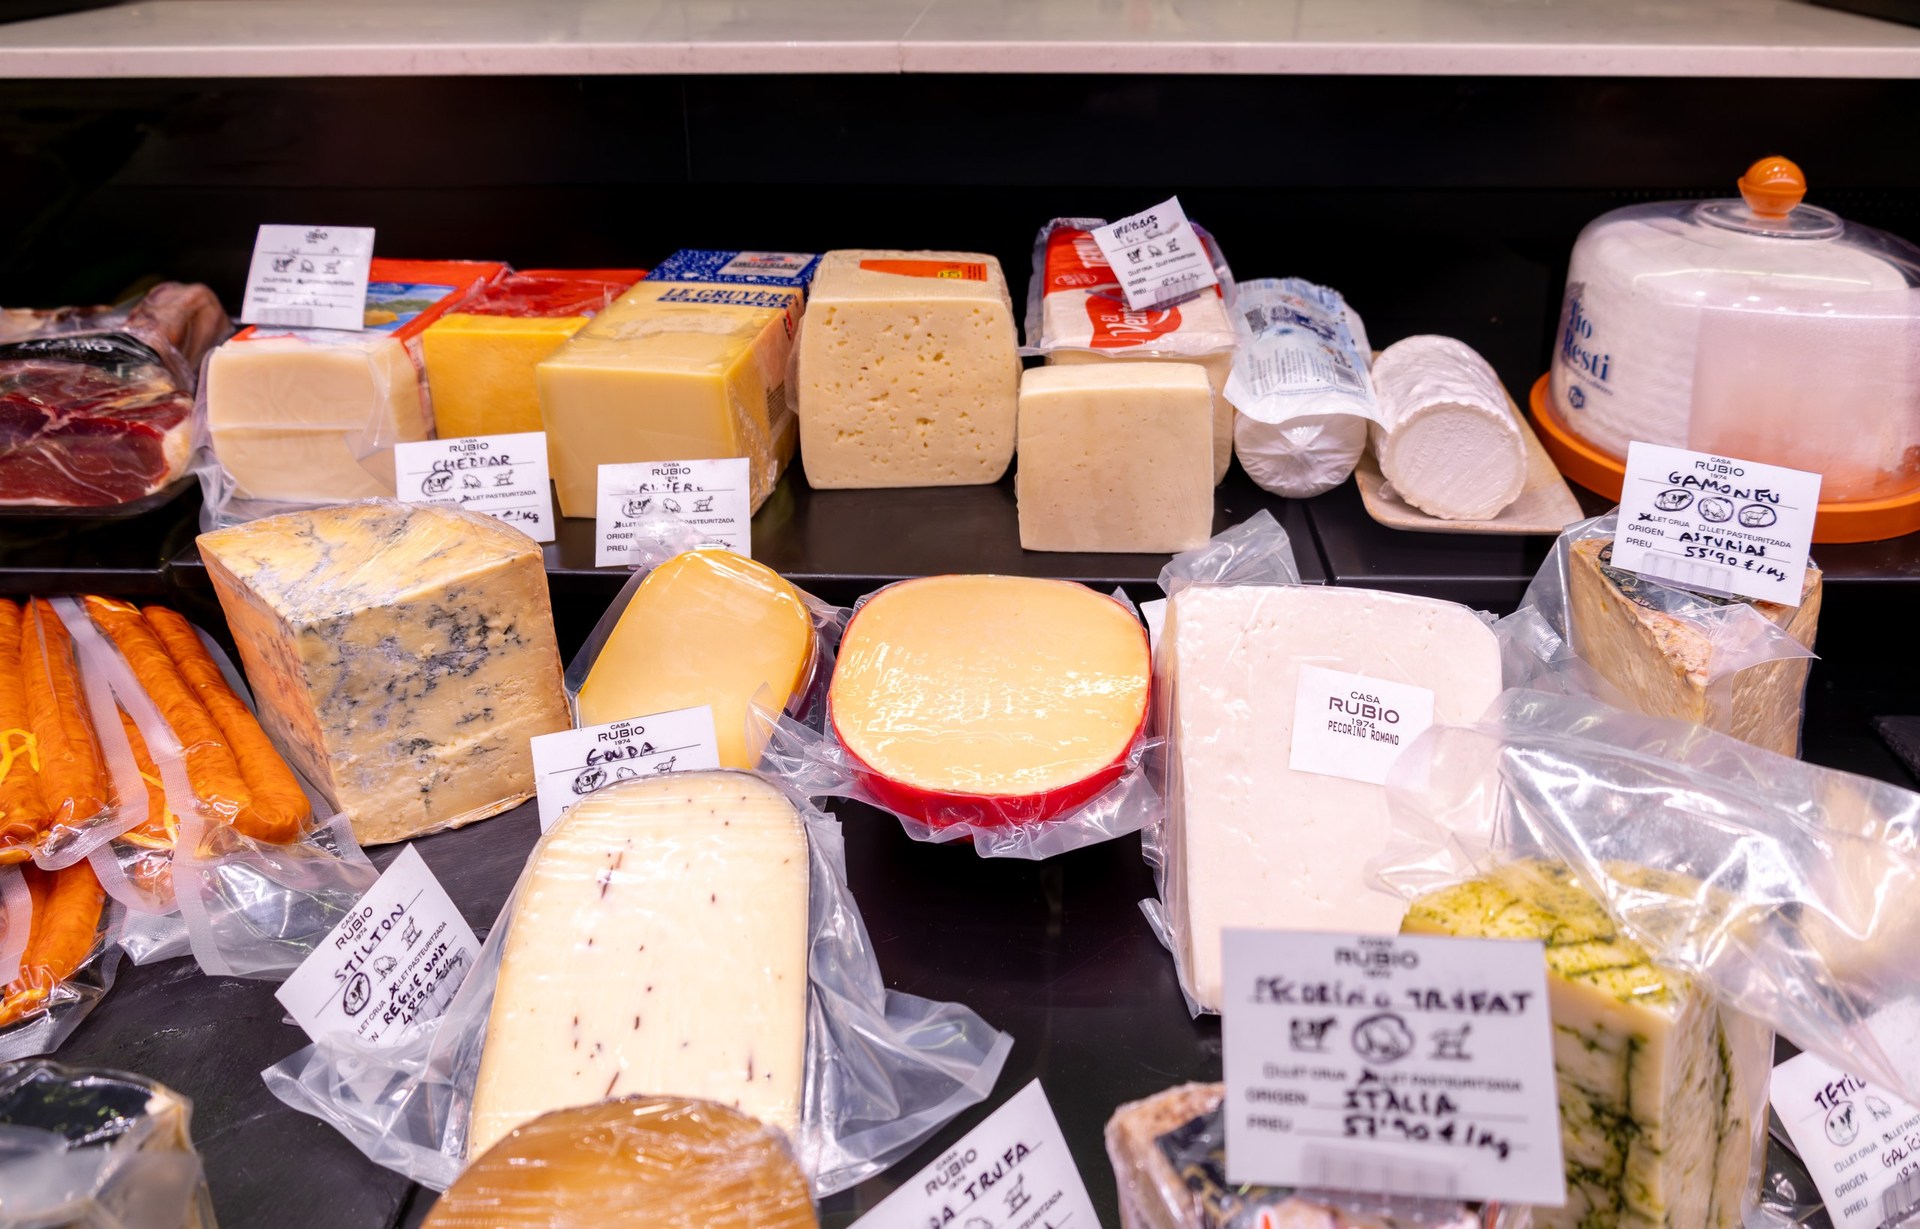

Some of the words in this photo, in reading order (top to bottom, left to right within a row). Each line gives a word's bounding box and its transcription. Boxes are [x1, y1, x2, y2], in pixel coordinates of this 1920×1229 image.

[666, 288, 694, 297] LE
[449, 442, 489, 453] RUBIO
[432, 455, 512, 473] CHEDDAR
[1695, 461, 1744, 477] RUBIO
[1710, 457, 1731, 465] CASA
[652, 468, 691, 476] RUBIO
[485, 490, 537, 500] PASTEURITZADA
[1628, 523, 1664, 537] ORIGEN
[1679, 532, 1766, 557] ASTURIAS
[1668, 518, 1690, 527] CRUA
[1706, 527, 1725, 536] LLET
[1727, 530, 1792, 548] PASTEURITZADA
[1626, 537, 1652, 549] PREU
[1684, 546, 1737, 566] 55'90
[1350, 691, 1380, 704] CASA
[1329, 696, 1400, 724] RUBIO
[610, 722, 631, 730] CASA
[1328, 720, 1367, 738] PECORINO
[1371, 729, 1400, 746] ROMANO
[1351, 718, 1375, 729] 1974
[597, 725, 645, 743] RUBIO
[614, 738, 631, 746] 1974
[586, 742, 656, 766] GOUDA
[335, 906, 373, 950] RUBIO
[340, 911, 358, 930] CASA
[335, 903, 405, 983] STILTON
[354, 927, 368, 943] 1974
[1334, 947, 1420, 969] RUBIO
[369, 1000, 387, 1021] CRUA
[408, 921, 447, 972] PASTEURITZADA
[1245, 1089, 1309, 1106] ORIGEN
[1343, 1088, 1458, 1116] ITALIA
[1246, 1115, 1293, 1132] PREU
[1841, 1151, 1861, 1170] LLET
[1860, 1142, 1879, 1157] CRUA
[924, 1149, 977, 1197] RUBIO
[964, 1142, 1031, 1202] TRUFA
[1834, 1171, 1869, 1198] ORIGEN
[1844, 1199, 1869, 1219] PREU
